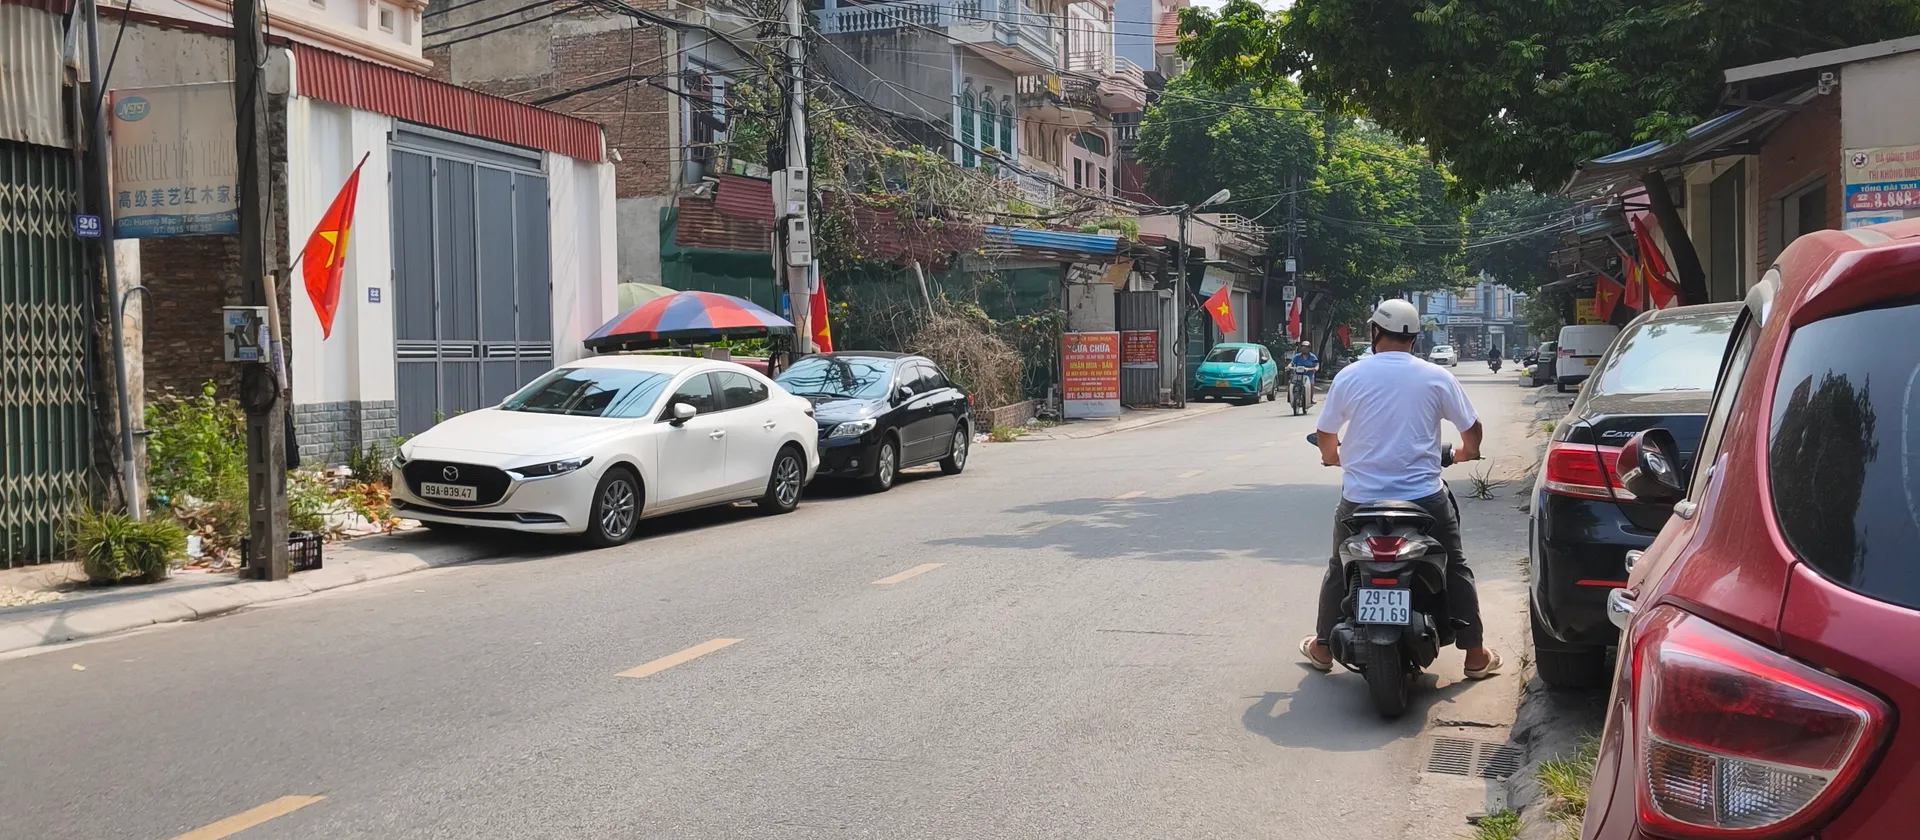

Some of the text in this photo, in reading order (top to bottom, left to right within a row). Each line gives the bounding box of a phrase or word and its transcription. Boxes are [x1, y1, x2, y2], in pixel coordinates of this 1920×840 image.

[115, 129, 170, 183] NGUYỄN
[172, 128, 195, 183] TẤT
[1880, 168, 1902, 179] KHÔNG
[1861, 184, 1882, 192] TỔNG
[80, 217, 98, 230] 26
[1090, 342, 1110, 352] CHỮA
[1070, 361, 1084, 370] NHẬN
[1102, 360, 1113, 368] BÁN
[426, 485, 472, 498] 99A-839.47
[1365, 591, 1402, 606] 29-C1
[1360, 607, 1407, 622] 221.69
